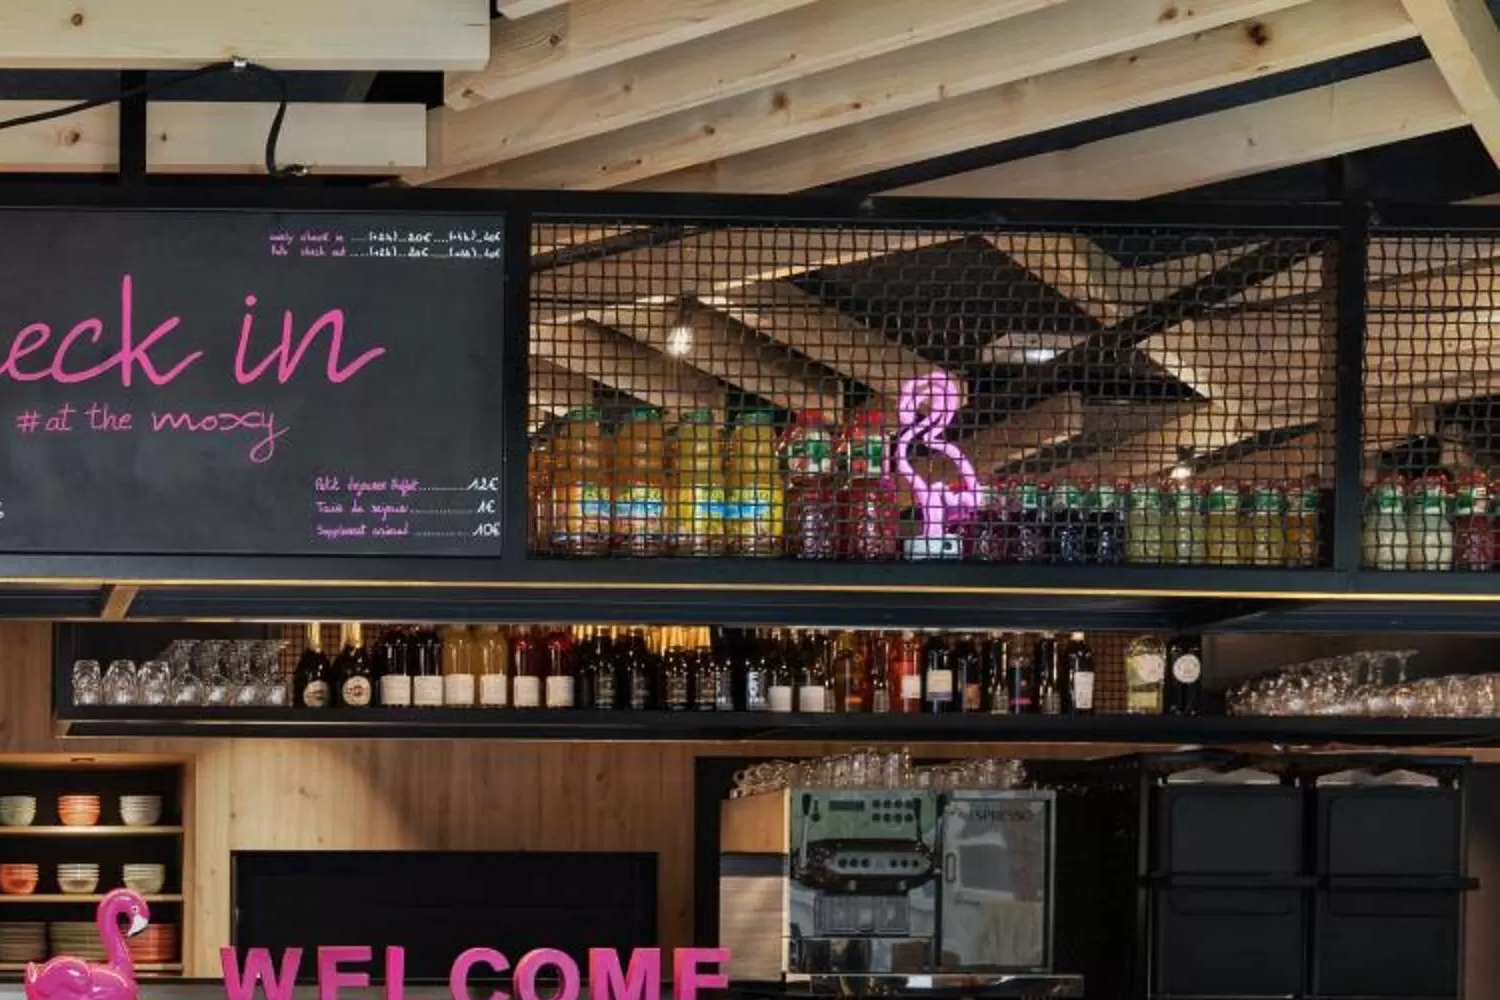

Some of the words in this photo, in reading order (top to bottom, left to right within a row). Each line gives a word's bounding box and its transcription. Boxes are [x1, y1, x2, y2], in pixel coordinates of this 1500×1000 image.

[235, 294, 388, 386] in
[15, 402, 77, 433] #at
[83, 402, 133, 432] the
[151, 406, 290, 463] moxy
